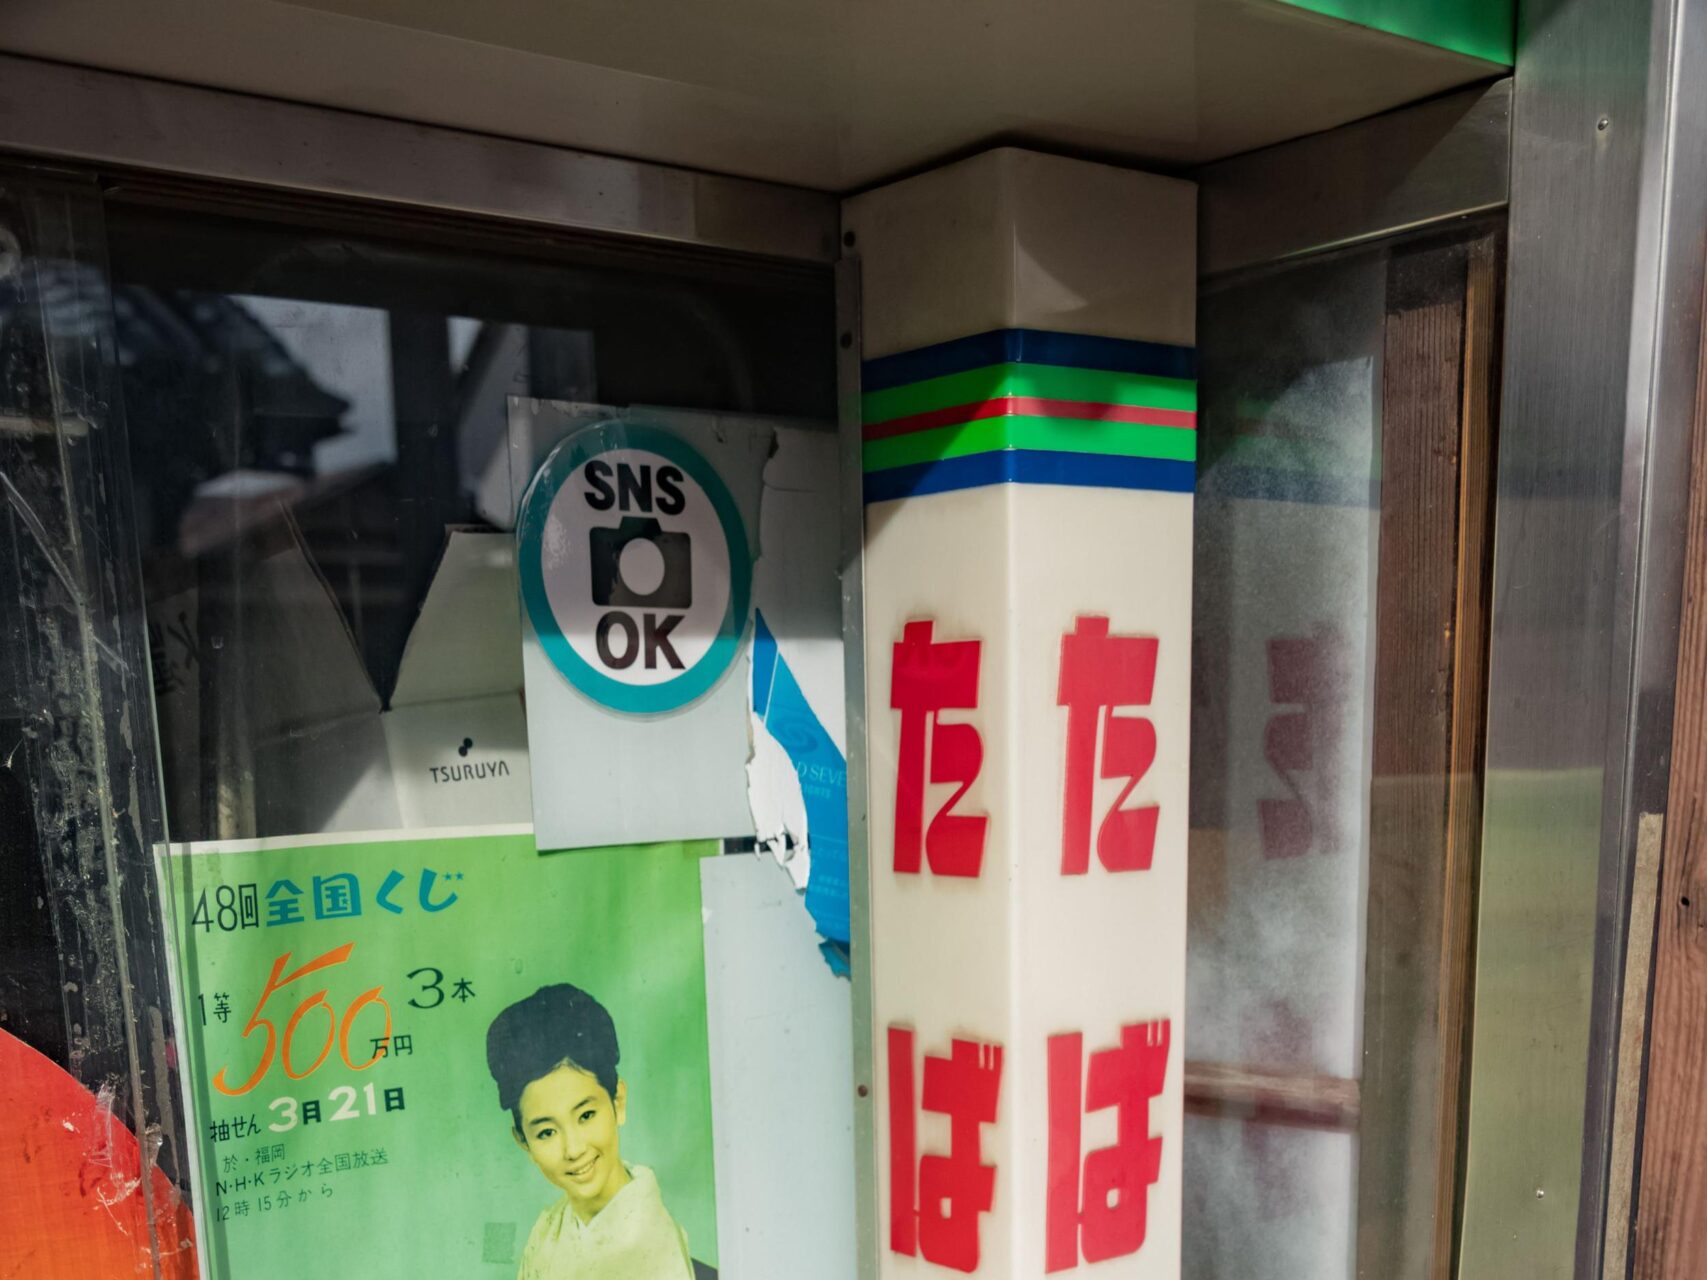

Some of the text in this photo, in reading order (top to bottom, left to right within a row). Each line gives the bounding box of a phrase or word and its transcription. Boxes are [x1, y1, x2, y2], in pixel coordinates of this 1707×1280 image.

[584, 460, 686, 516] SNS
[595, 611, 686, 670] OK
[429, 759, 510, 784] TSURUYA
[192, 868, 464, 933] 48回 全国くじ
[198, 992, 232, 1026] 1等
[406, 967, 476, 1010] 3本
